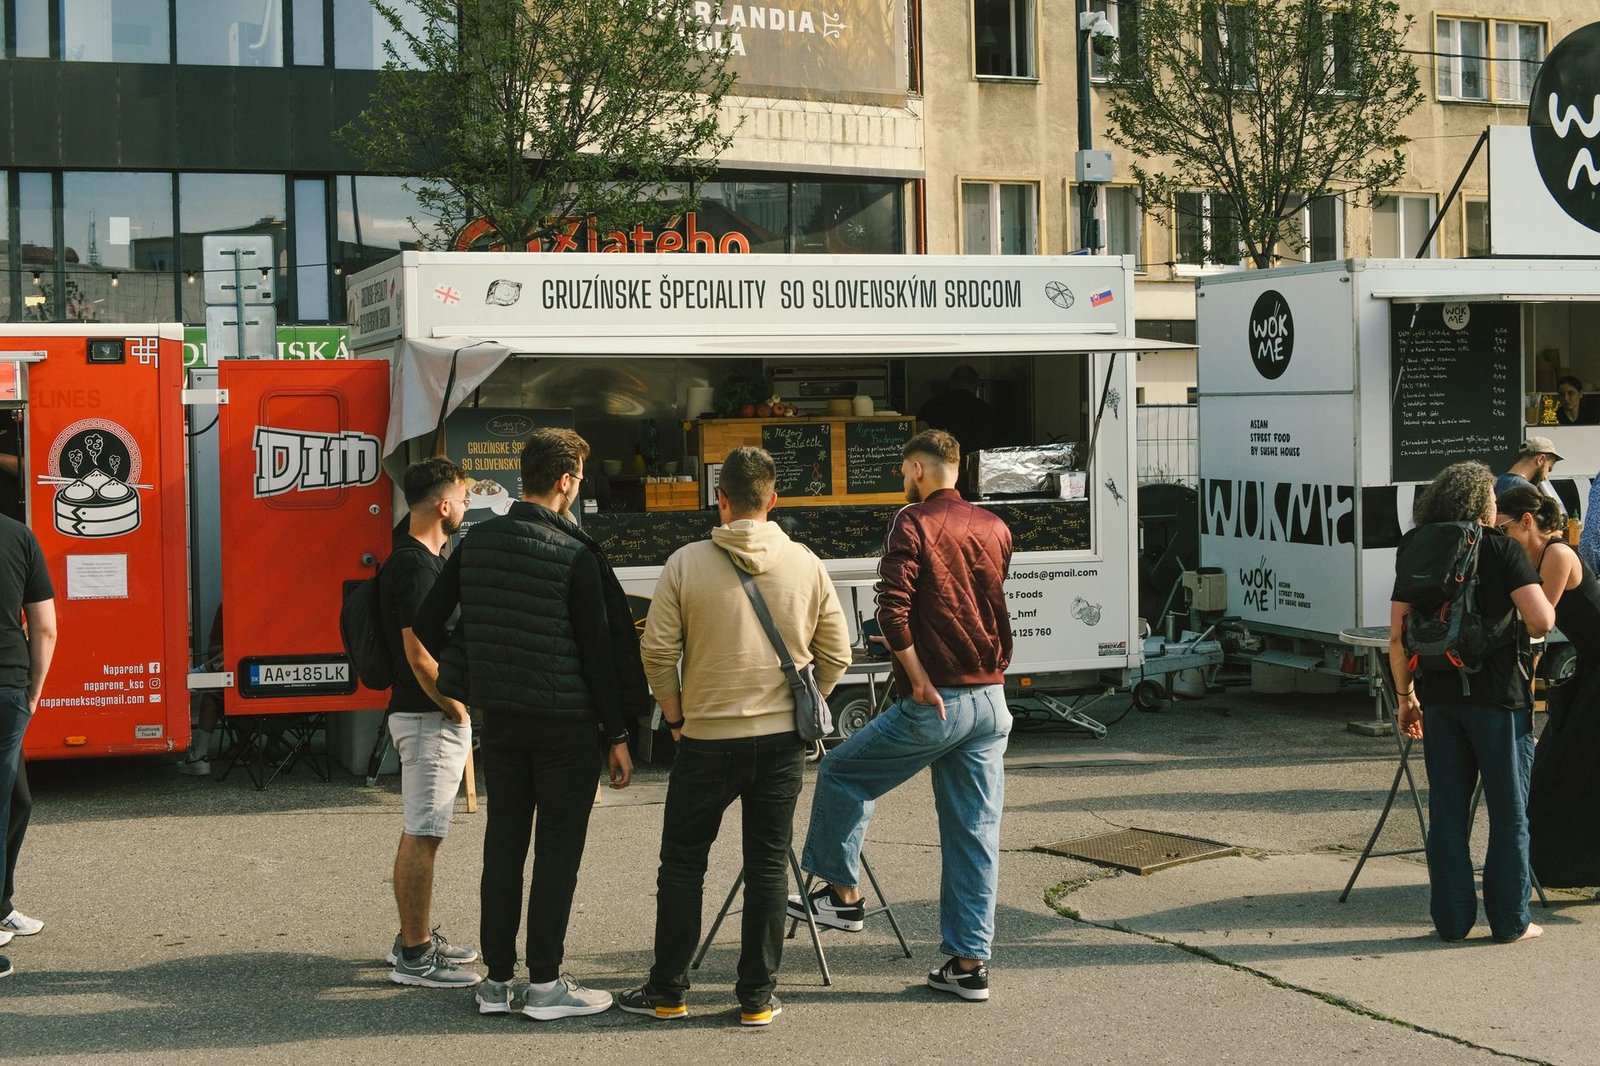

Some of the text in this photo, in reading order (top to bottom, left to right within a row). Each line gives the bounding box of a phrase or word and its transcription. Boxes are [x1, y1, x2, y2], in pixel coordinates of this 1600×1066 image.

[542, 273, 1022, 309] GRUZÍNSKE ŠPECIALITY SO SLOVENSKÝM SRDCOM
[1446, 307, 1467, 316] WOK
[1253, 313, 1288, 339] WOK
[1448, 315, 1464, 324] ME
[1257, 337, 1284, 363] ME
[1250, 419, 1268, 429] ASIAN
[1250, 433, 1291, 443] STREET FOOD
[467, 440, 510, 455] GRUZÍNSKE
[1250, 446, 1300, 457] BY SUSHI HOUSE
[462, 456, 521, 471] SO SLOVENSKÝ
[1007, 568, 1098, 581] s.foods@gmail.com
[1240, 568, 1273, 590] WOK
[1004, 590, 1043, 599] 's Foods
[1244, 589, 1269, 612] ME
[1008, 609, 1037, 620] s_hmf
[1011, 627, 1052, 638] 4 125 760
[103, 663, 144, 676] Naparené
[84, 679, 144, 692] naparene_ksc
[40, 694, 145, 708] napareneksc@gmail.com
